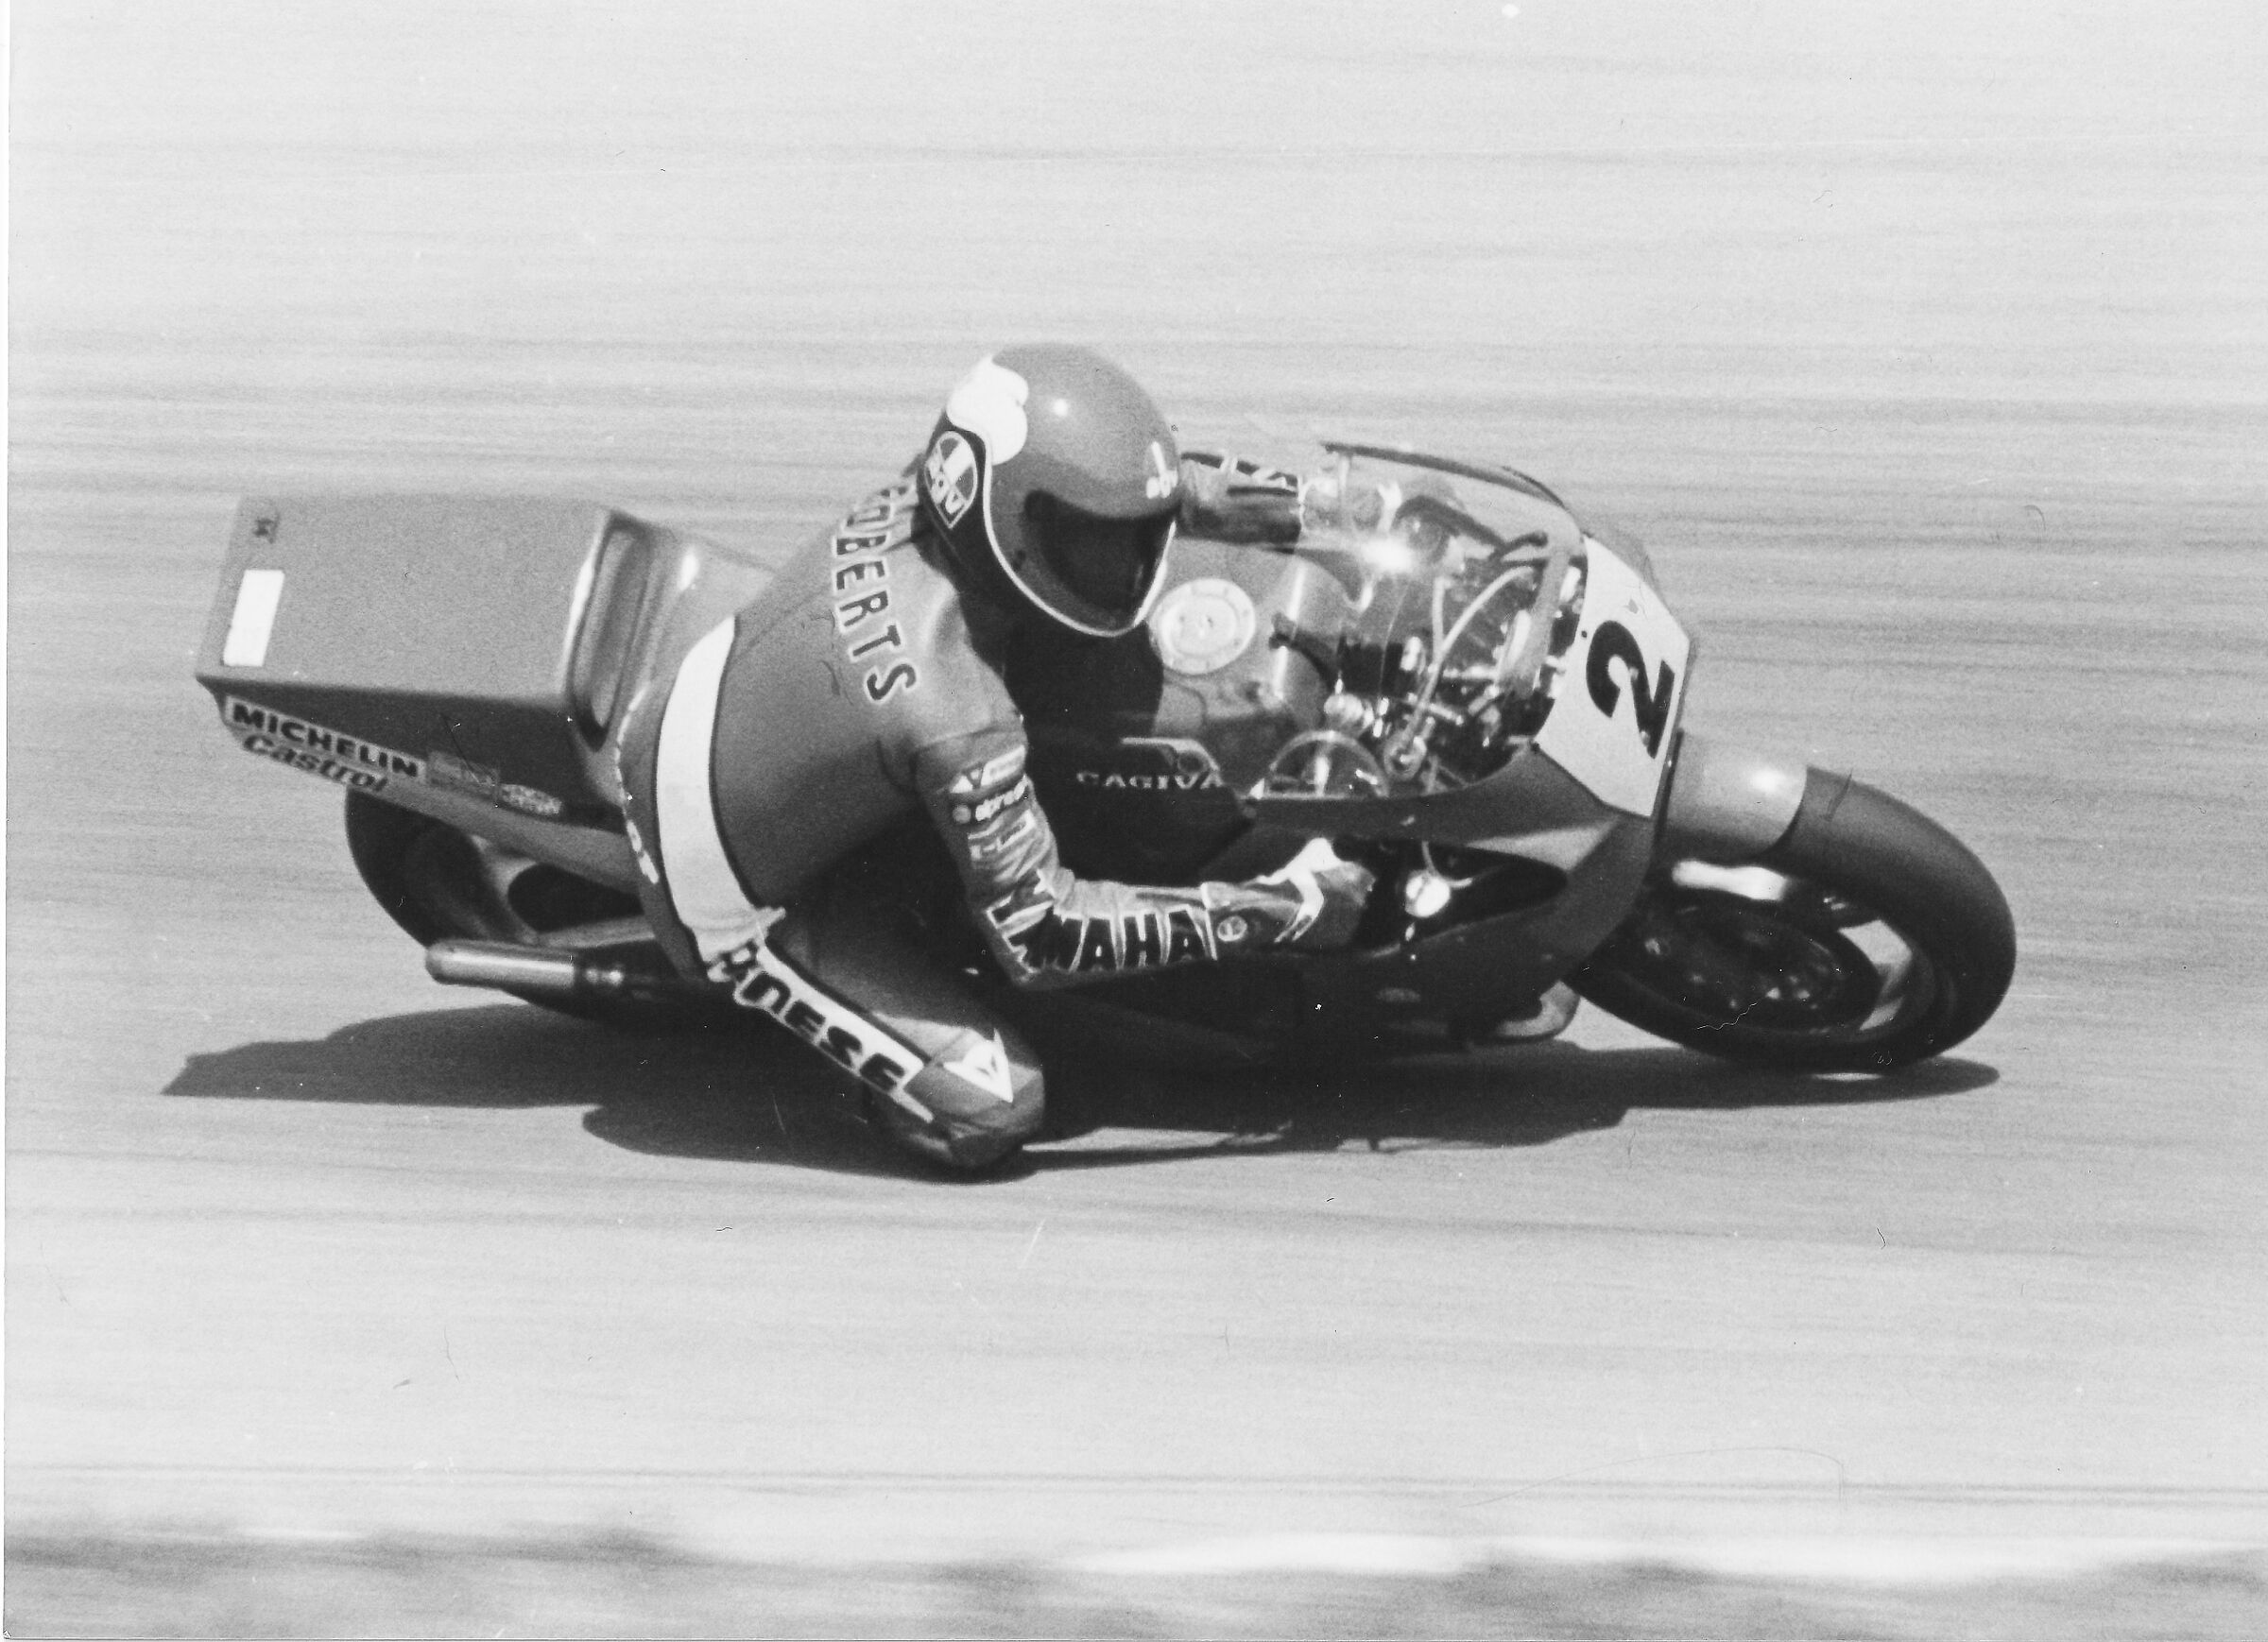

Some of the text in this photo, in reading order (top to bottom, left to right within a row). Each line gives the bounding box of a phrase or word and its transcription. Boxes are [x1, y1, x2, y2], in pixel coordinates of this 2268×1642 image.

[1586, 620, 1675, 760] 2
[232, 702, 420, 778] MICHELIN
[1075, 771, 1224, 790] CAGIVA
